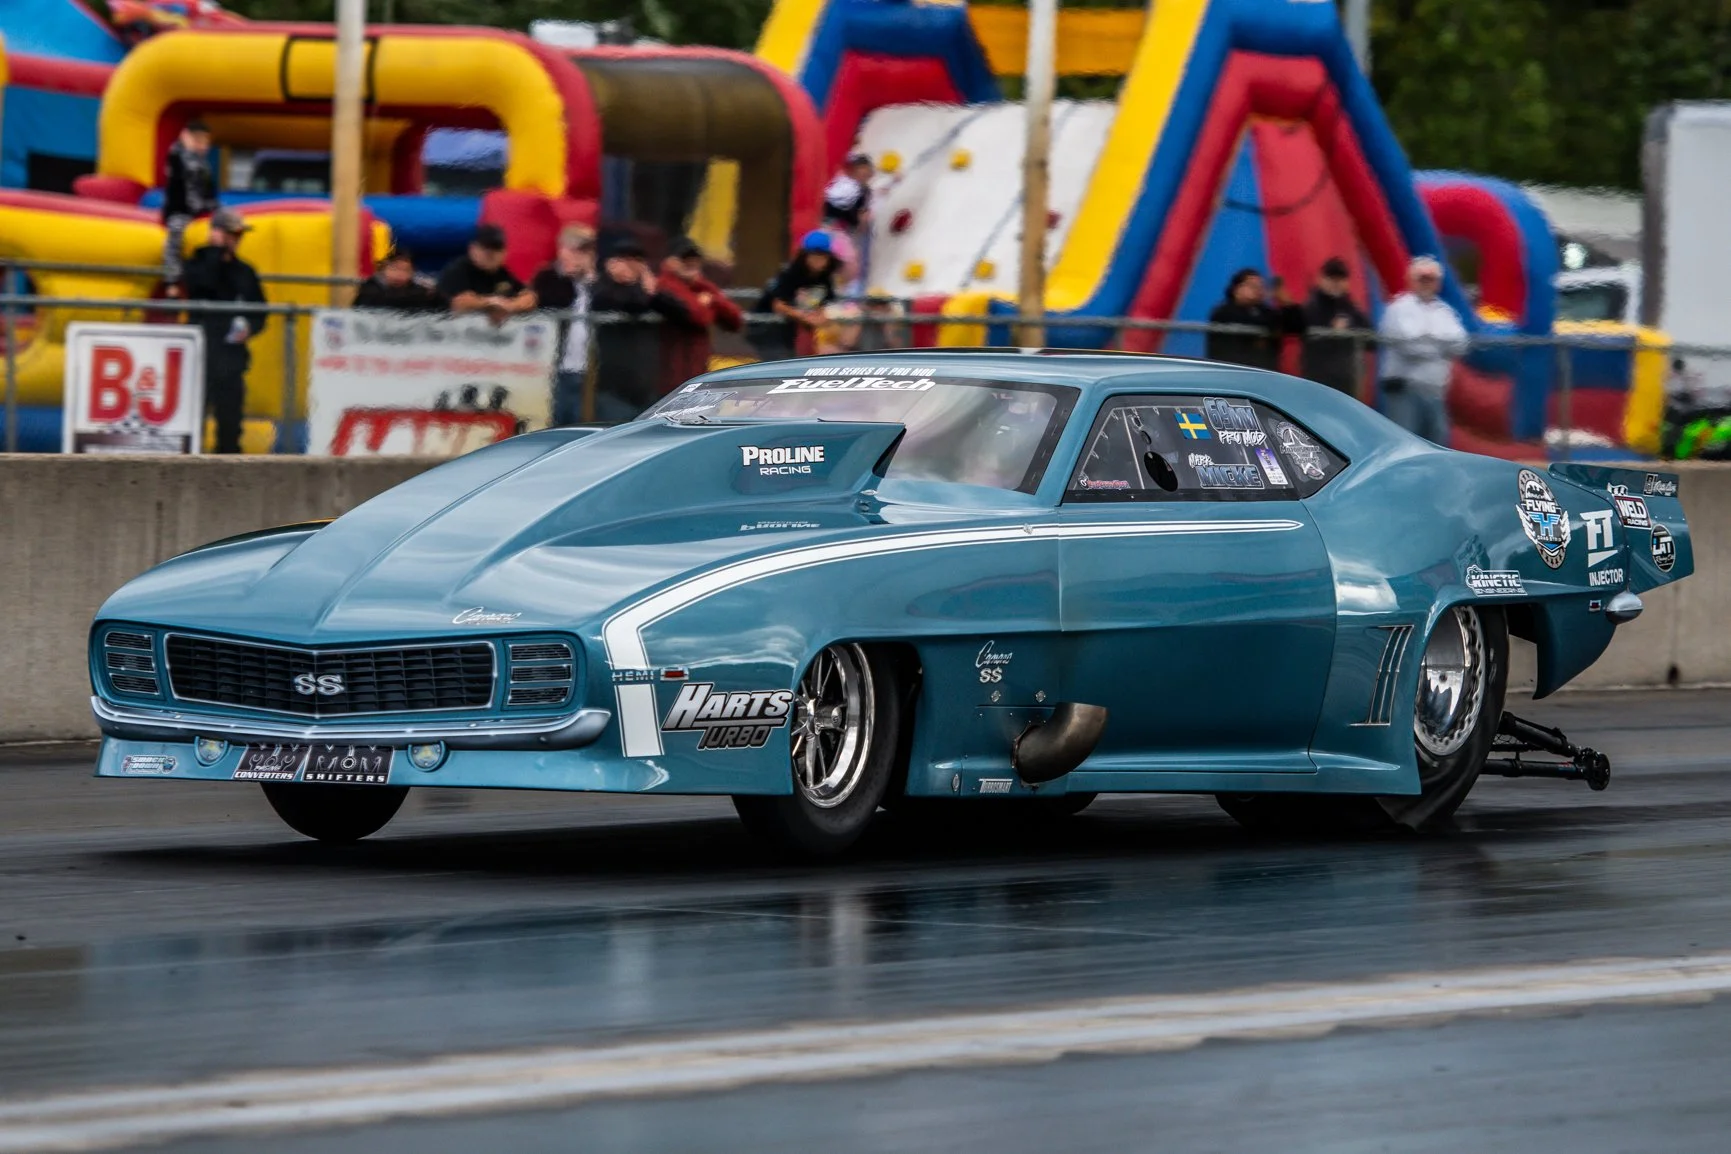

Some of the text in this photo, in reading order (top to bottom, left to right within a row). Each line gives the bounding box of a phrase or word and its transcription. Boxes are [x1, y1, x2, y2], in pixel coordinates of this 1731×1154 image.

[804, 367, 936, 376] WORLD SERIES OF PRO MOD
[89, 345, 184, 426] B&J
[777, 377, 936, 391] FuelTech
[738, 445, 825, 466] PROLINE
[759, 465, 812, 476] RACING
[1195, 464, 1265, 489] MICKE
[1526, 499, 1556, 514] FLYING
[1616, 499, 1647, 519] WELD
[1471, 574, 1521, 587] KINETIC
[1589, 568, 1624, 586] INJECTOR
[294, 673, 345, 696] SS
[612, 671, 654, 682] HEMI
[661, 683, 794, 731] HARTS
[698, 726, 772, 750] TURBO
[234, 770, 295, 780] CONVERTERS
[306, 772, 387, 783] SHIFTERS
